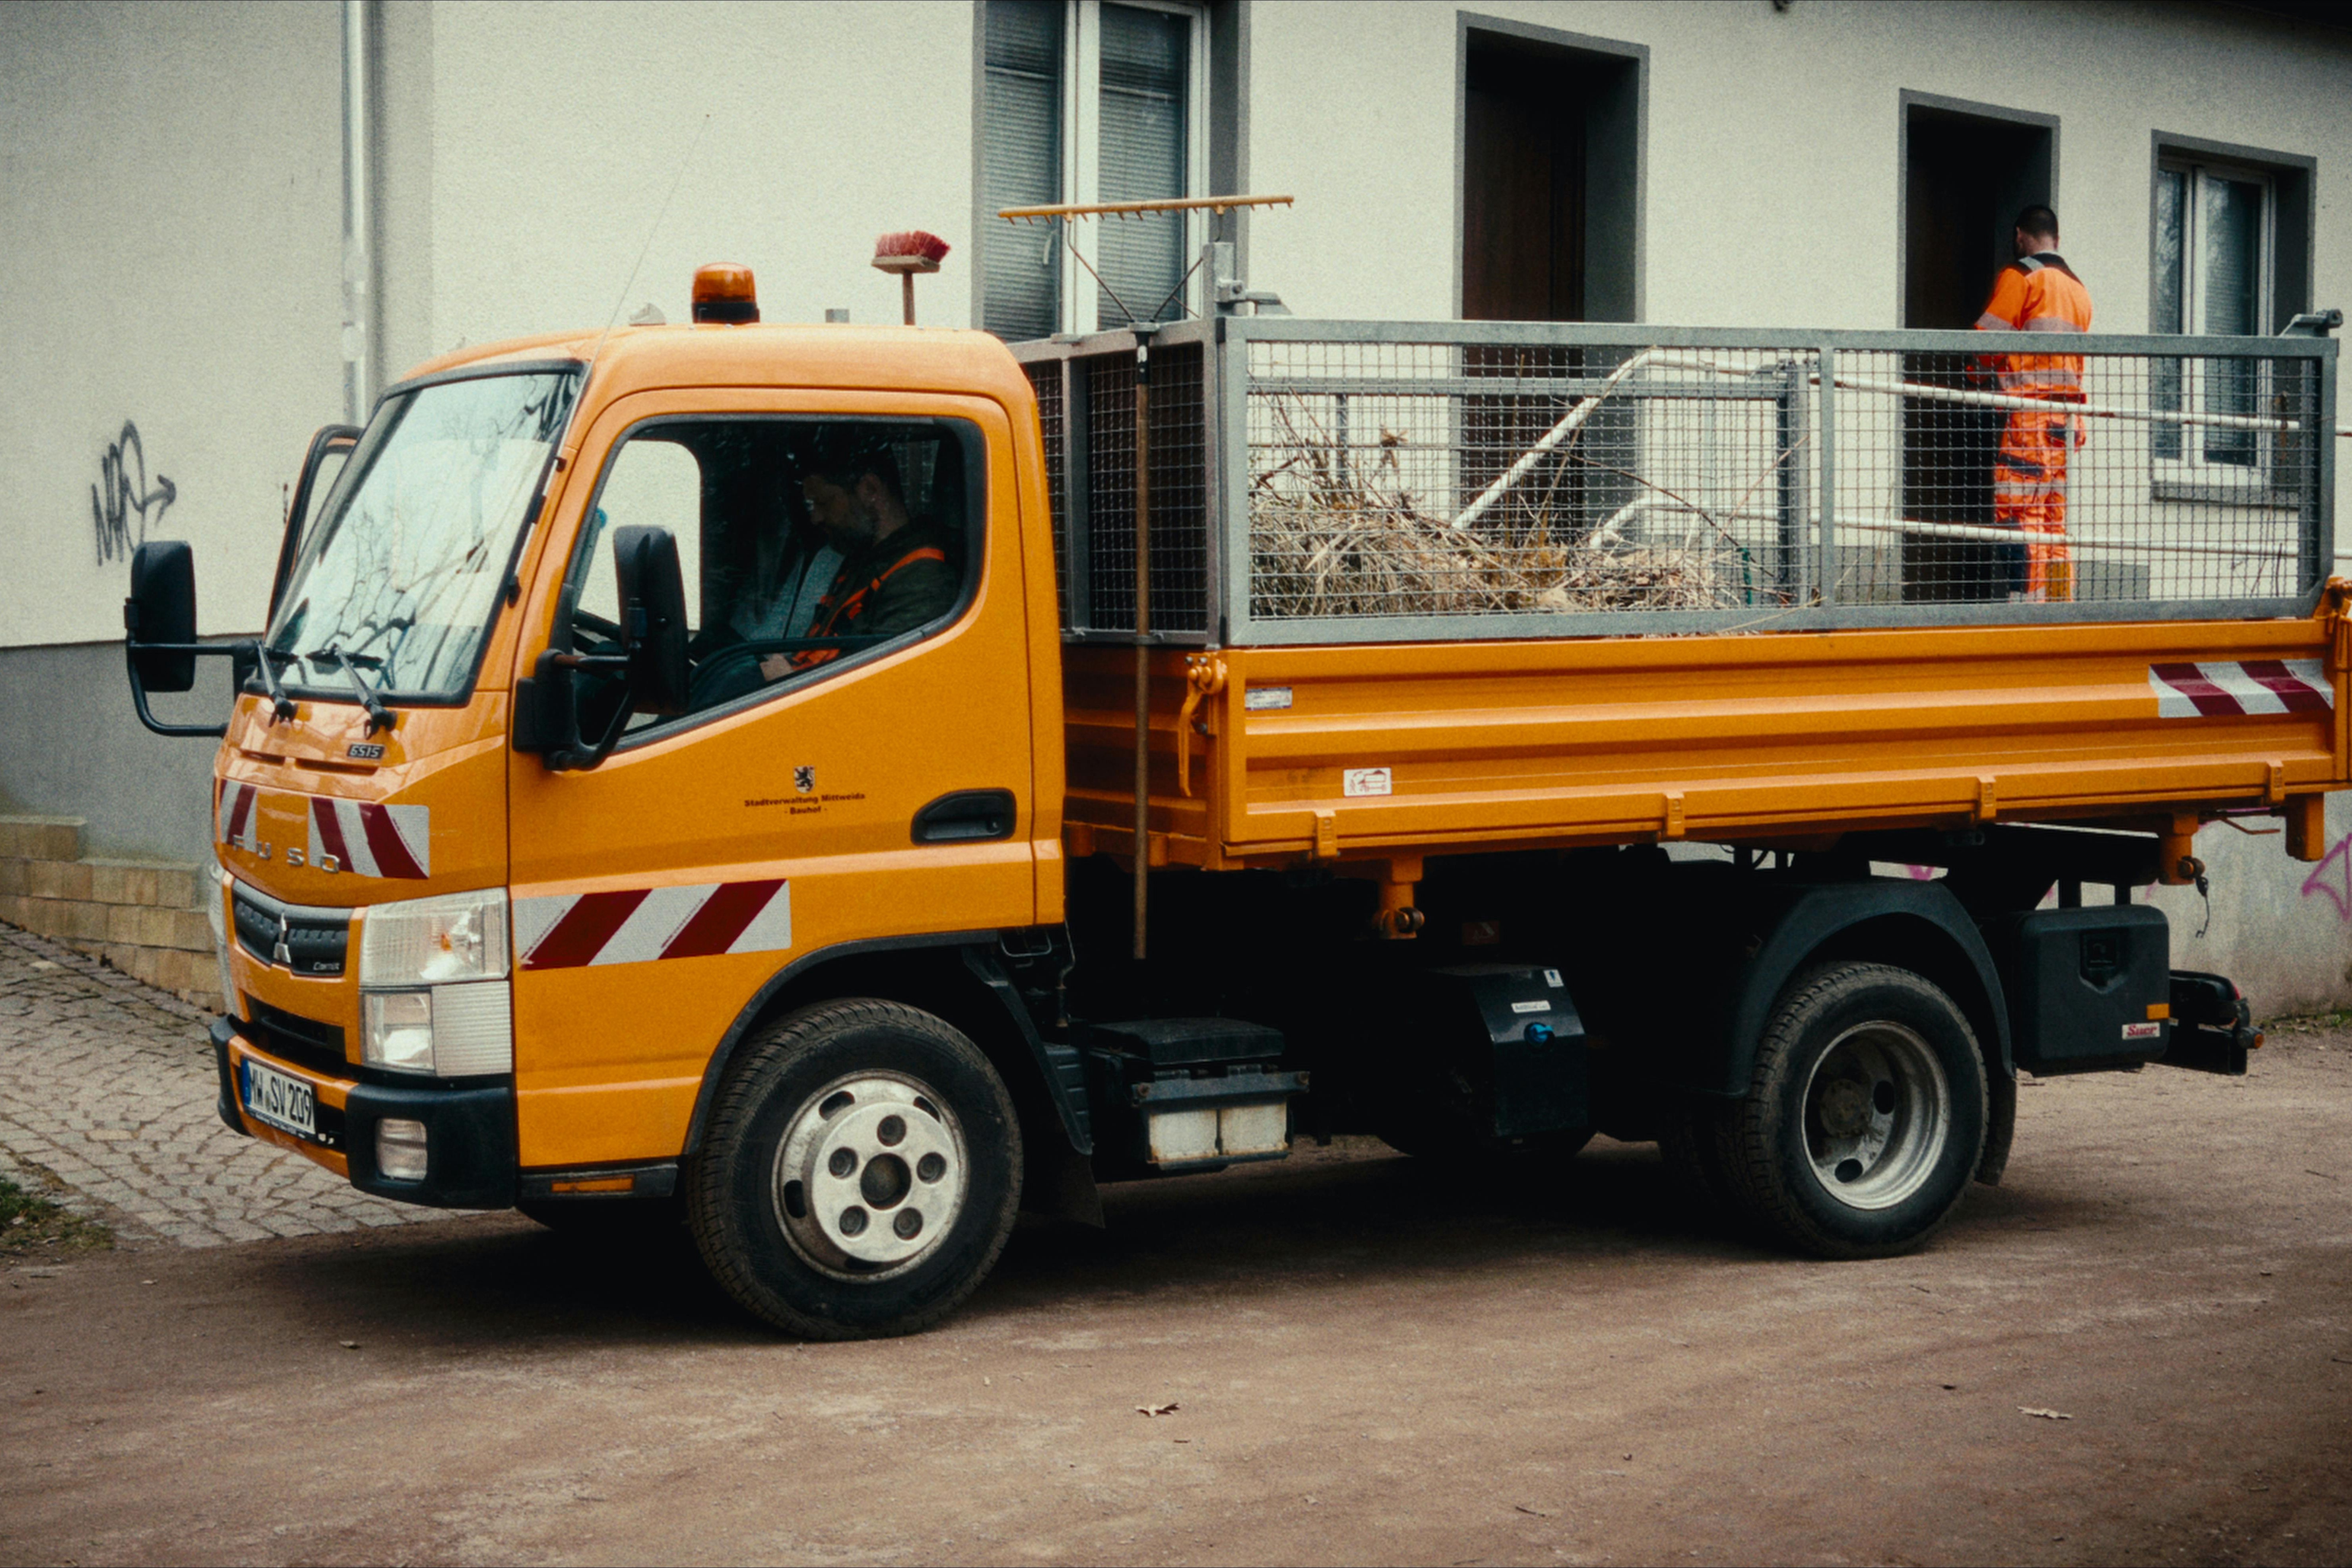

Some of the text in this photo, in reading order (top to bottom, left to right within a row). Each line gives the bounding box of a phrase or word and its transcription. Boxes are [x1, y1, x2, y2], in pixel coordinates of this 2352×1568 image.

[744, 793, 866, 807] Stadtverwaltung Mittweida
[790, 806, 821, 815] Bauhof
[232, 834, 340, 873] FUSO
[2127, 1024, 2158, 1036] Suer
[270, 1075, 285, 1116] SV
[288, 1083, 312, 1126] 209
